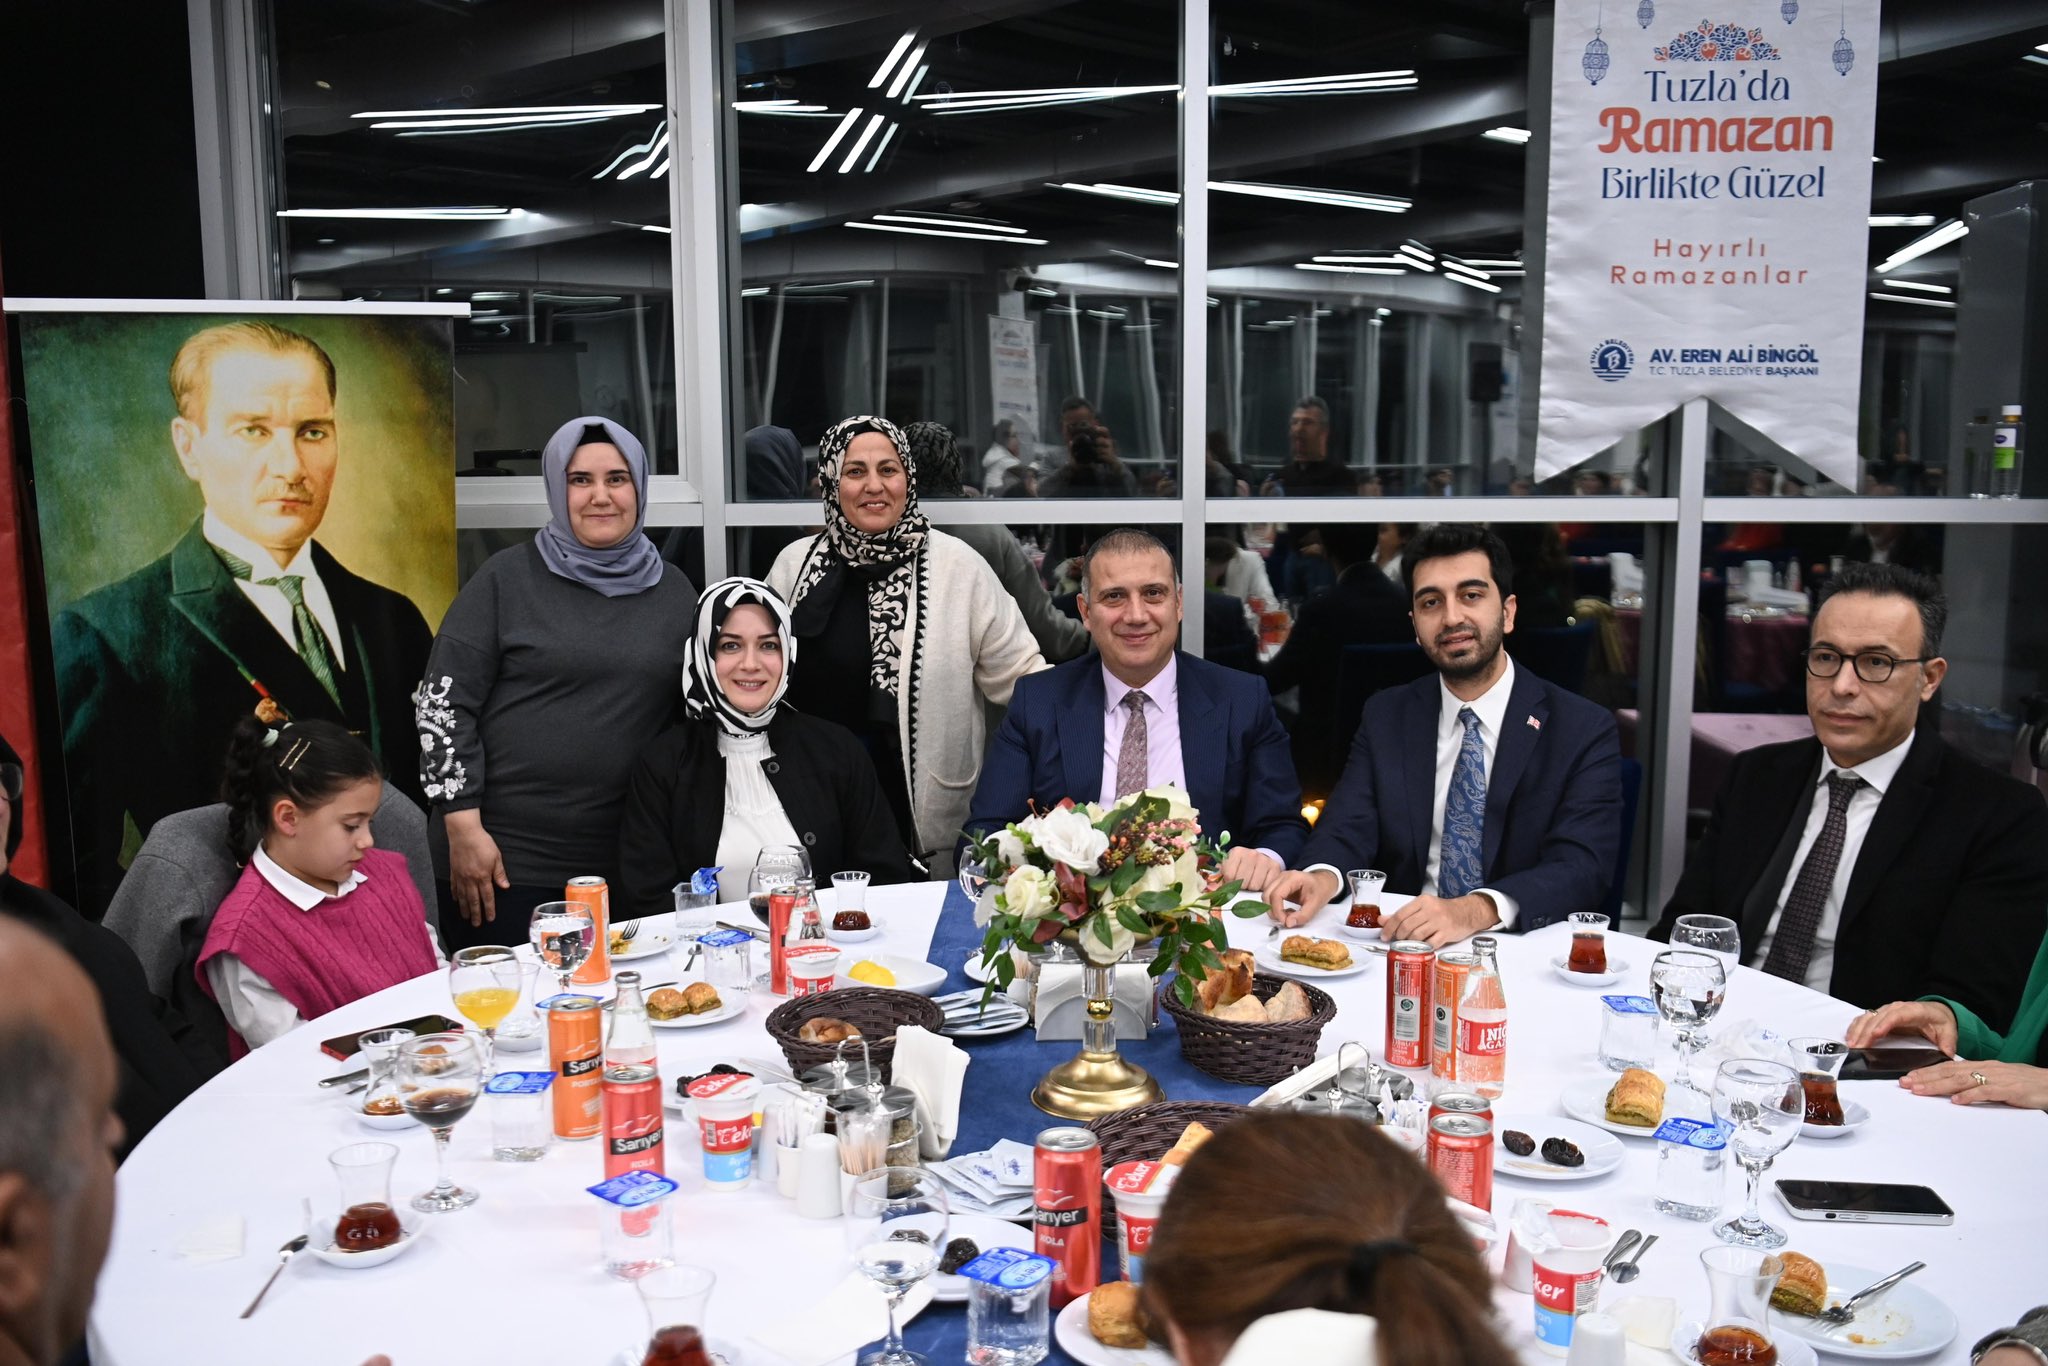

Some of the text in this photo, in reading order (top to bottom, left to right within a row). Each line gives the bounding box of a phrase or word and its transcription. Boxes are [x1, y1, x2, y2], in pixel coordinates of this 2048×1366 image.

[1598, 107, 1833, 153] Ramazan
[1601, 165, 1825, 199] Birlikte Güzel
[1653, 238, 1766, 261] Hayırlı
[1610, 264, 1809, 285] Ramazanlar
[1650, 344, 1819, 363] AV. EREN ALİ BİNGÖL
[1670, 367, 1706, 376] TUZLA
[1709, 366, 1762, 376] BELEDİYE
[1765, 366, 1819, 378] BAŞKANI
[1534, 1272, 1566, 1300] ker
